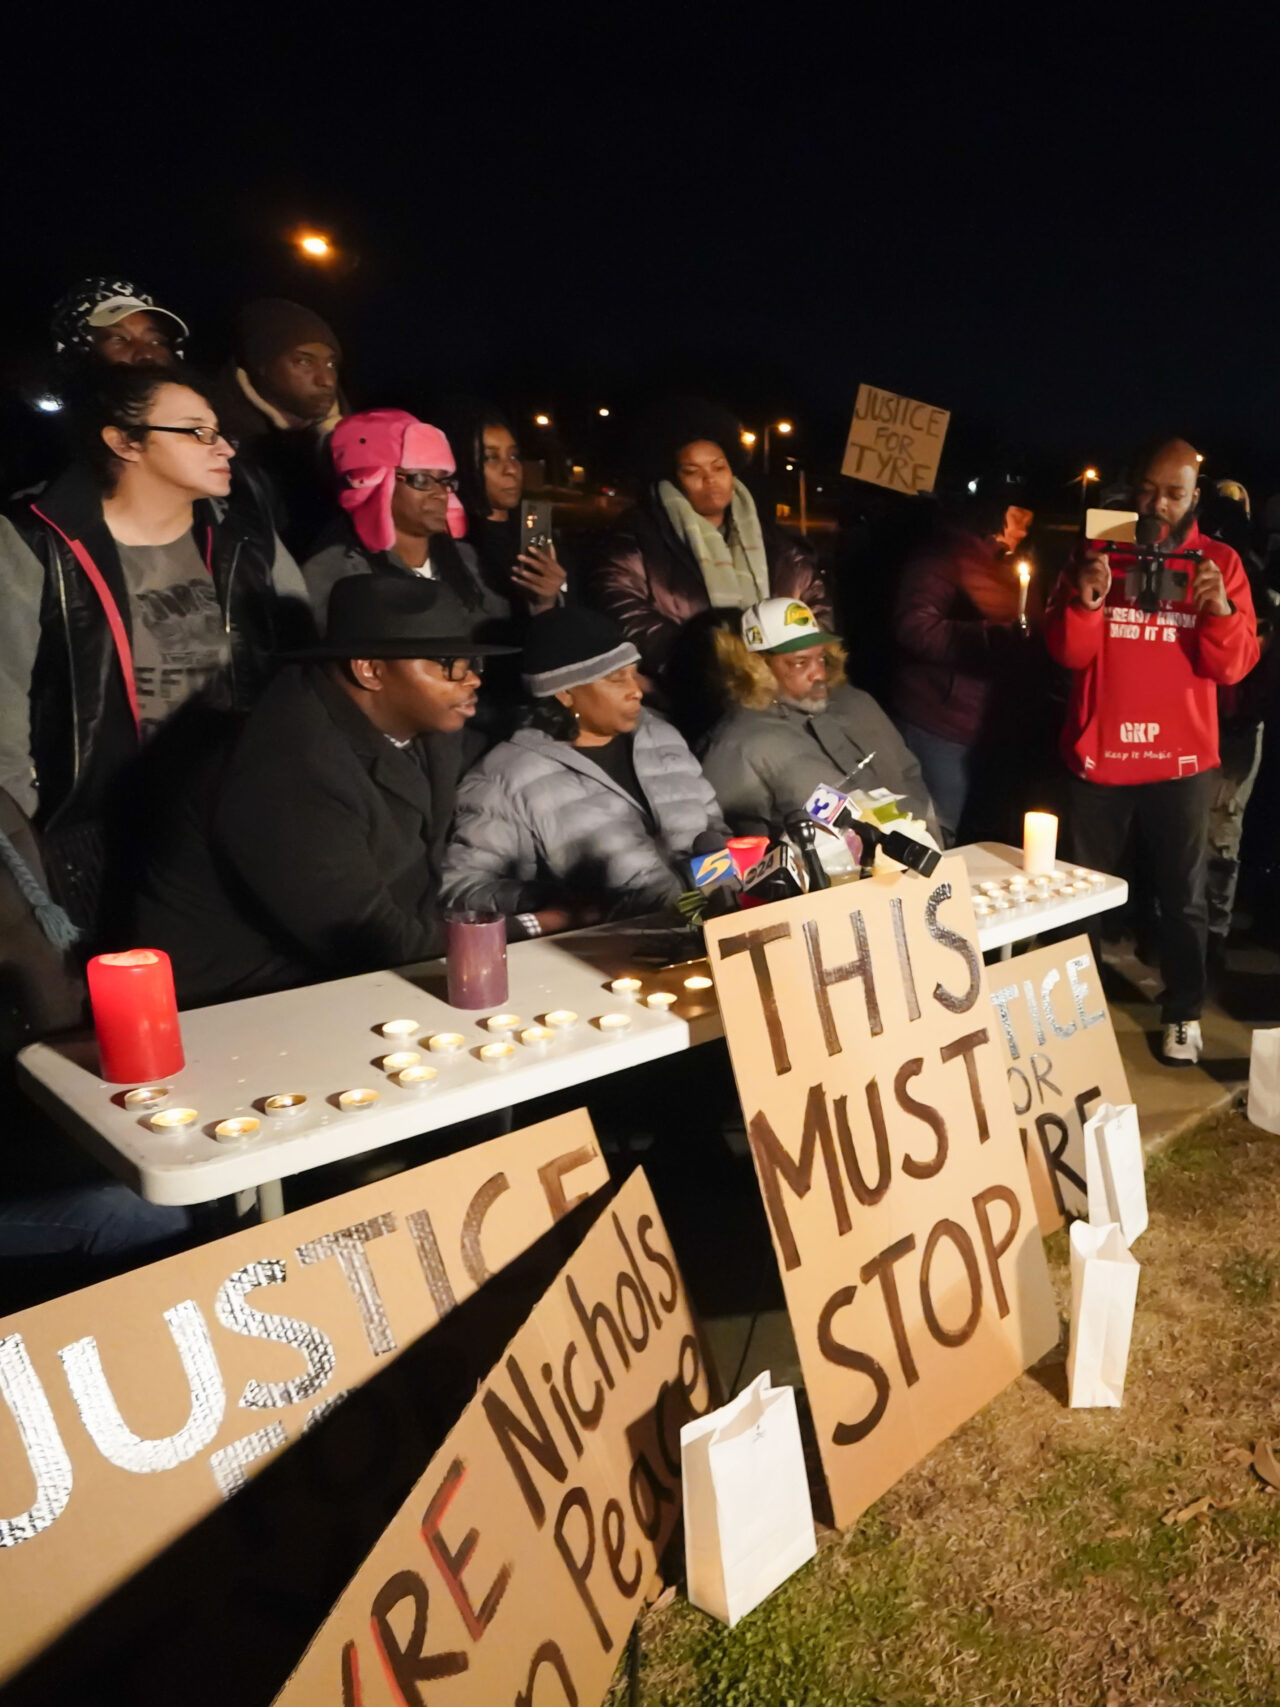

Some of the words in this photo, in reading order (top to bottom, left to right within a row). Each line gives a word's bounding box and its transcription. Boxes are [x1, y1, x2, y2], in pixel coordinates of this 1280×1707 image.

[855, 388, 946, 439] JUSTICE
[874, 426, 915, 462] FOR
[1120, 722, 1160, 743] GKP
[805, 788, 839, 820] 3
[696, 849, 732, 887] 5
[719, 883, 981, 1075] THIS
[990, 953, 1106, 1060] TICE
[1007, 1052, 1063, 1115] OR
[749, 1028, 990, 1270] MUST
[817, 1185, 1021, 1446] STOP
[342, 1456, 515, 1707] RE
[482, 1211, 678, 1532] Nichols
